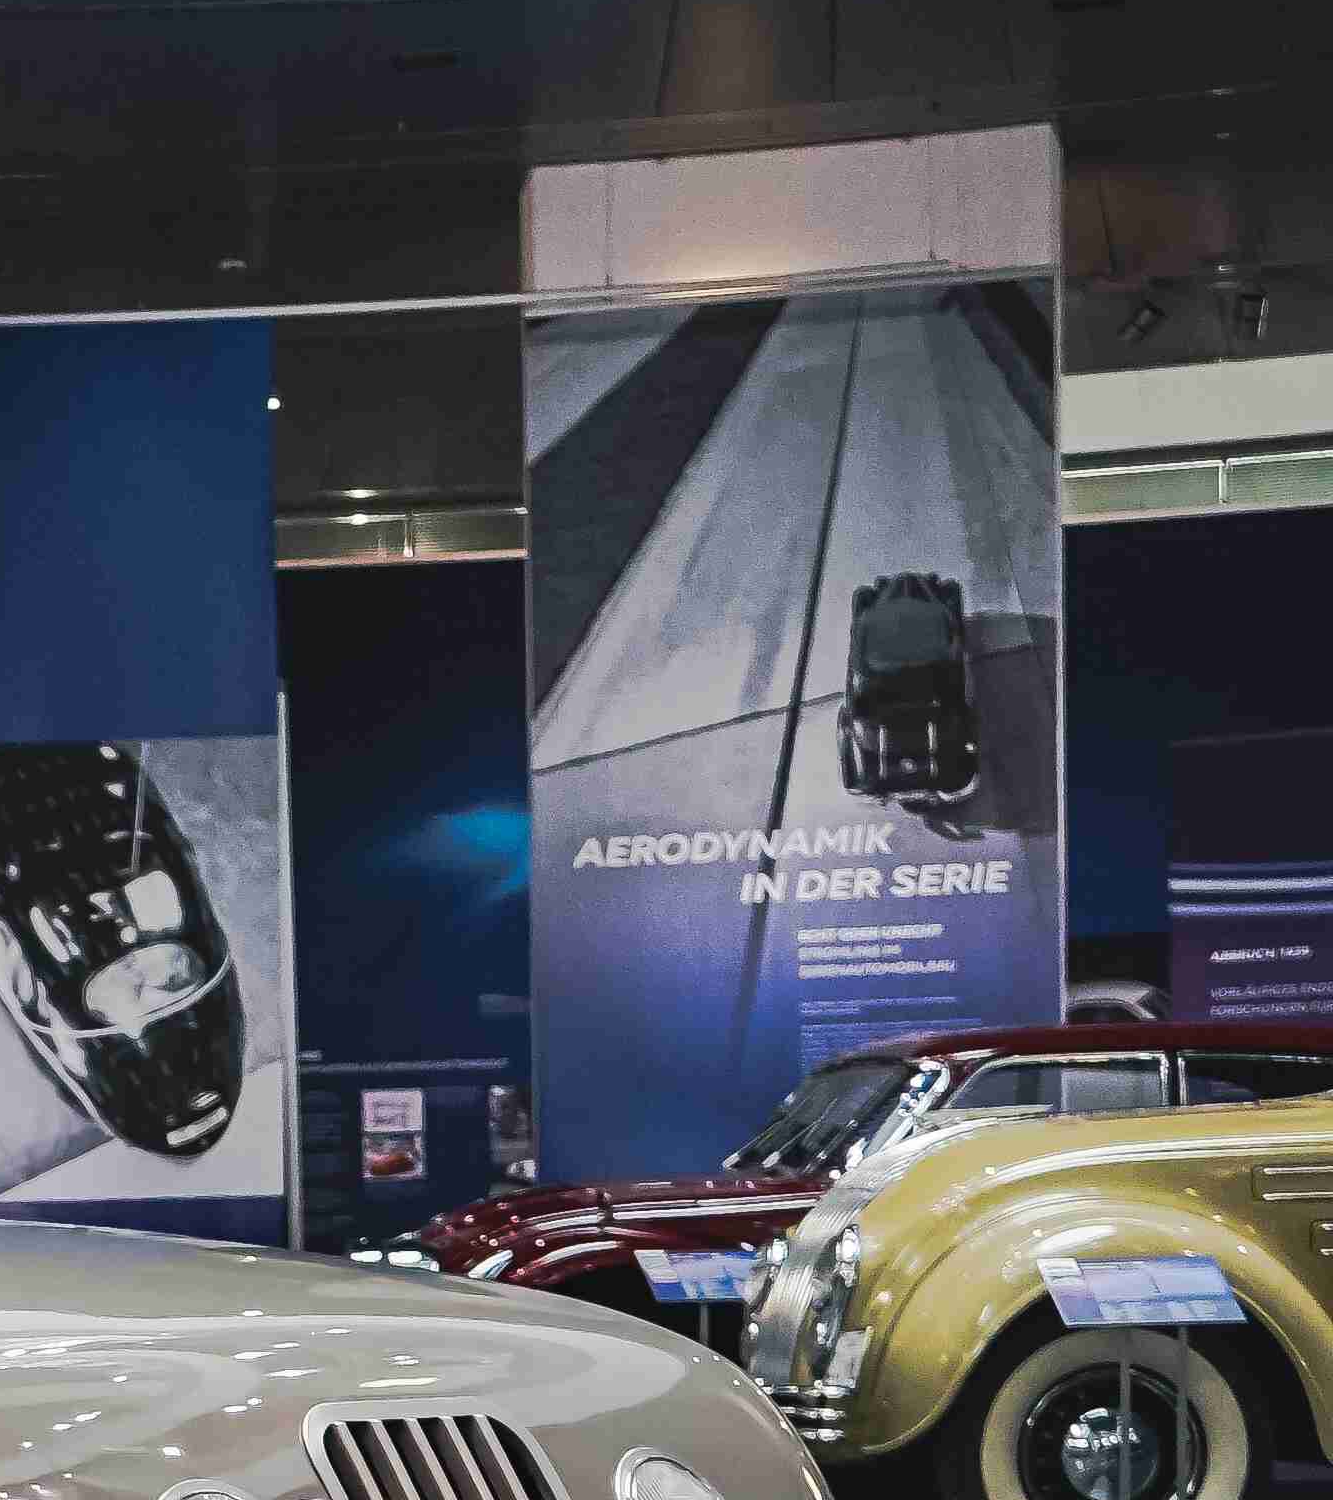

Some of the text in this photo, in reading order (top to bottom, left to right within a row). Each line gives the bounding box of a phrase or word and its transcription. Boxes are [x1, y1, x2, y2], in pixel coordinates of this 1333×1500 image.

[573, 823, 894, 868] AERODYNAMIK
[739, 860, 1013, 903] IN DER SERIE
